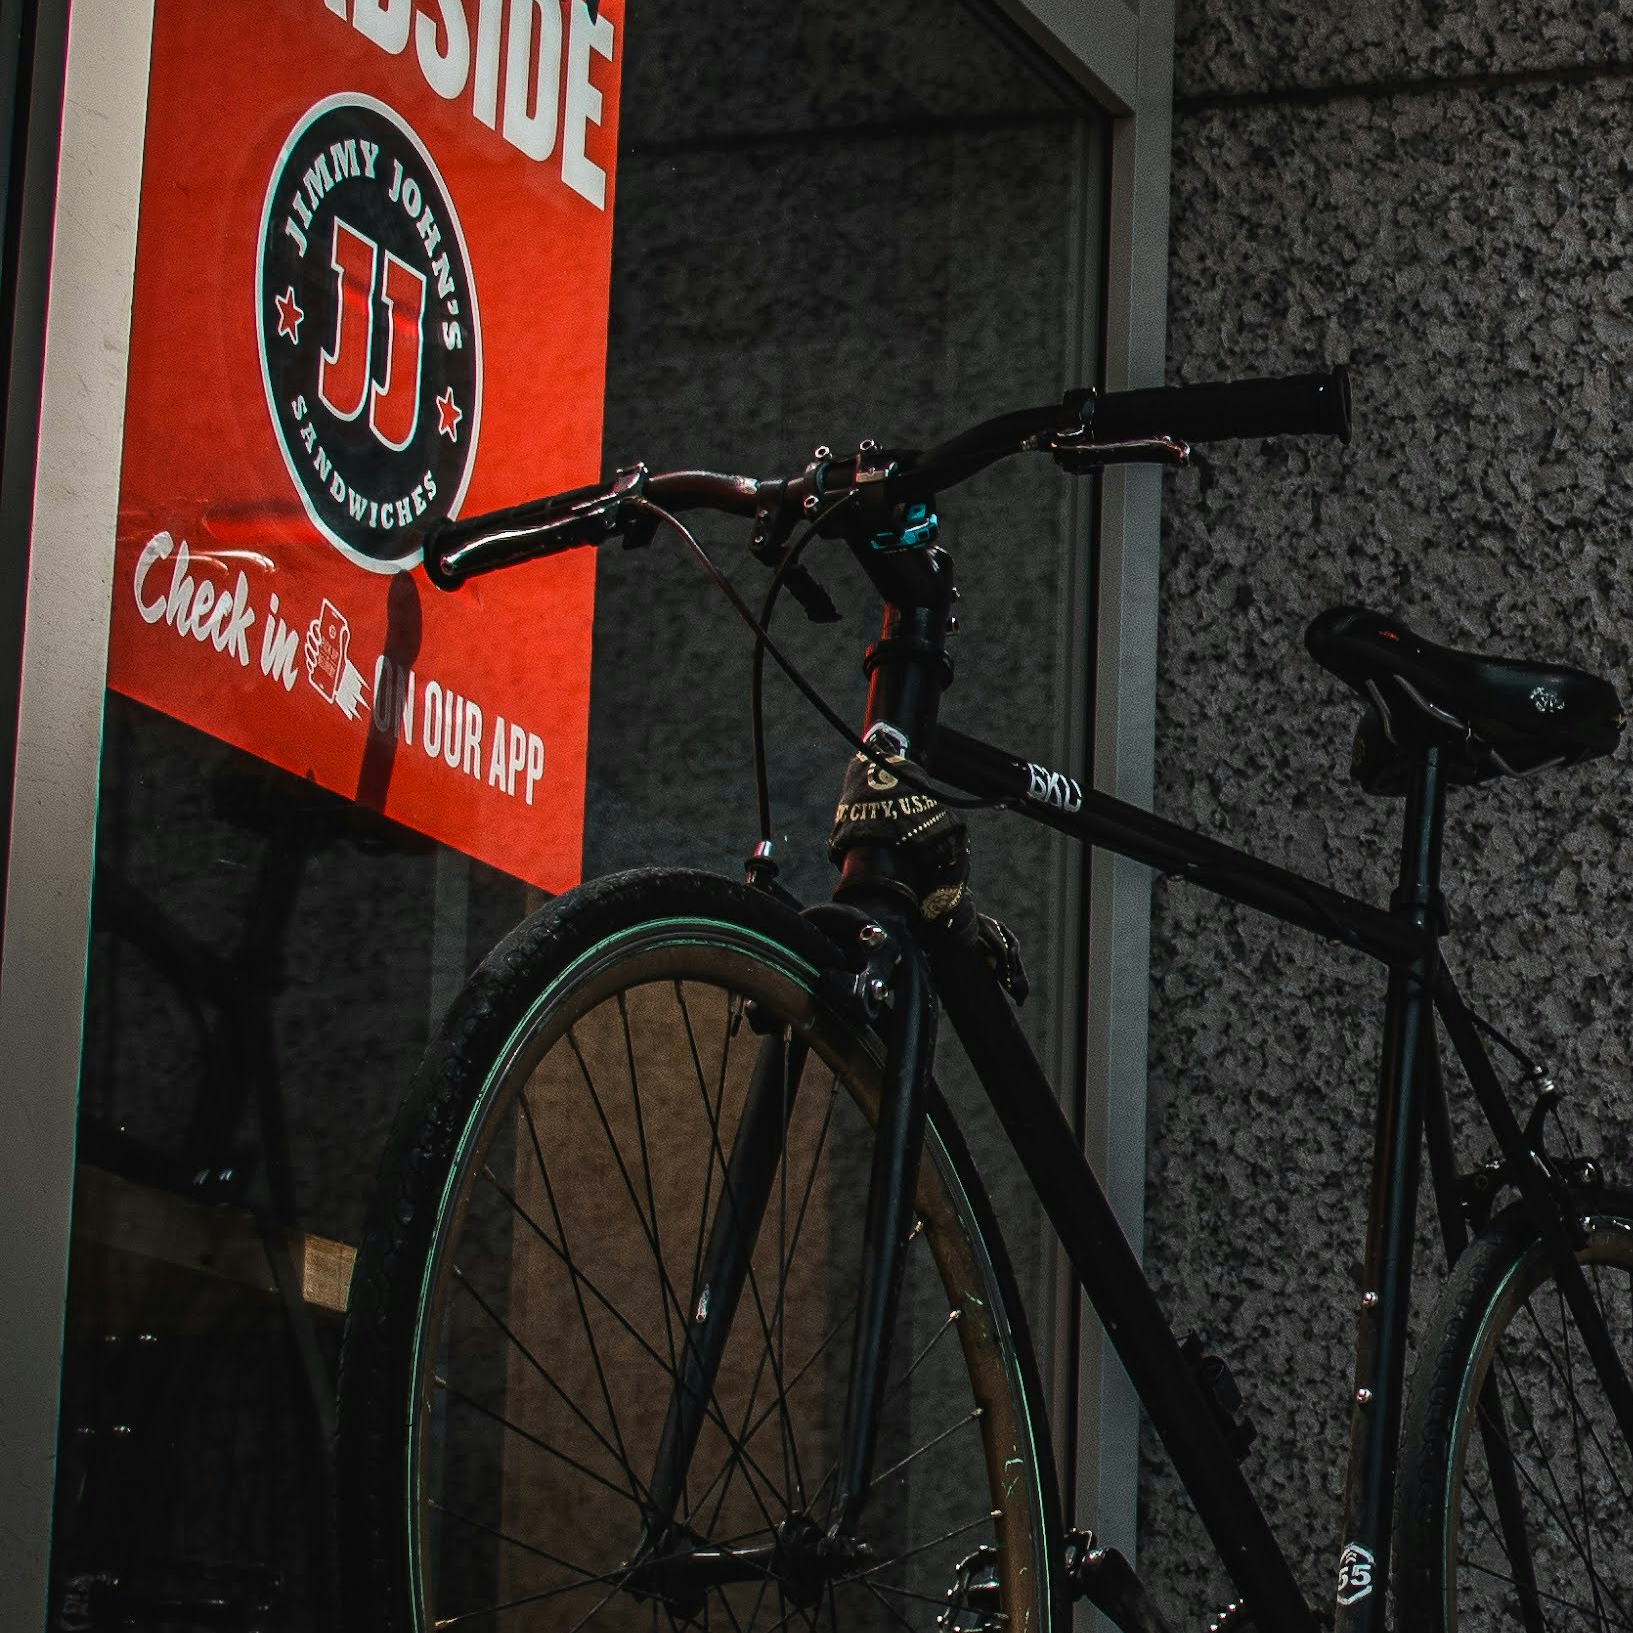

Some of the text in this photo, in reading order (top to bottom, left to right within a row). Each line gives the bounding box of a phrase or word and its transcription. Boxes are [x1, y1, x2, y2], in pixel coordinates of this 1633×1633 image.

[285, 137, 463, 351] JIMMY JOHN'S
[318, 217, 427, 452] JJ
[292, 395, 438, 531] SANDWICHES
[134, 530, 255, 667] Check
[260, 598, 300, 693] in
[373, 654, 415, 746] ON
[423, 681, 483, 786] OUR
[489, 717, 545, 805] APP
